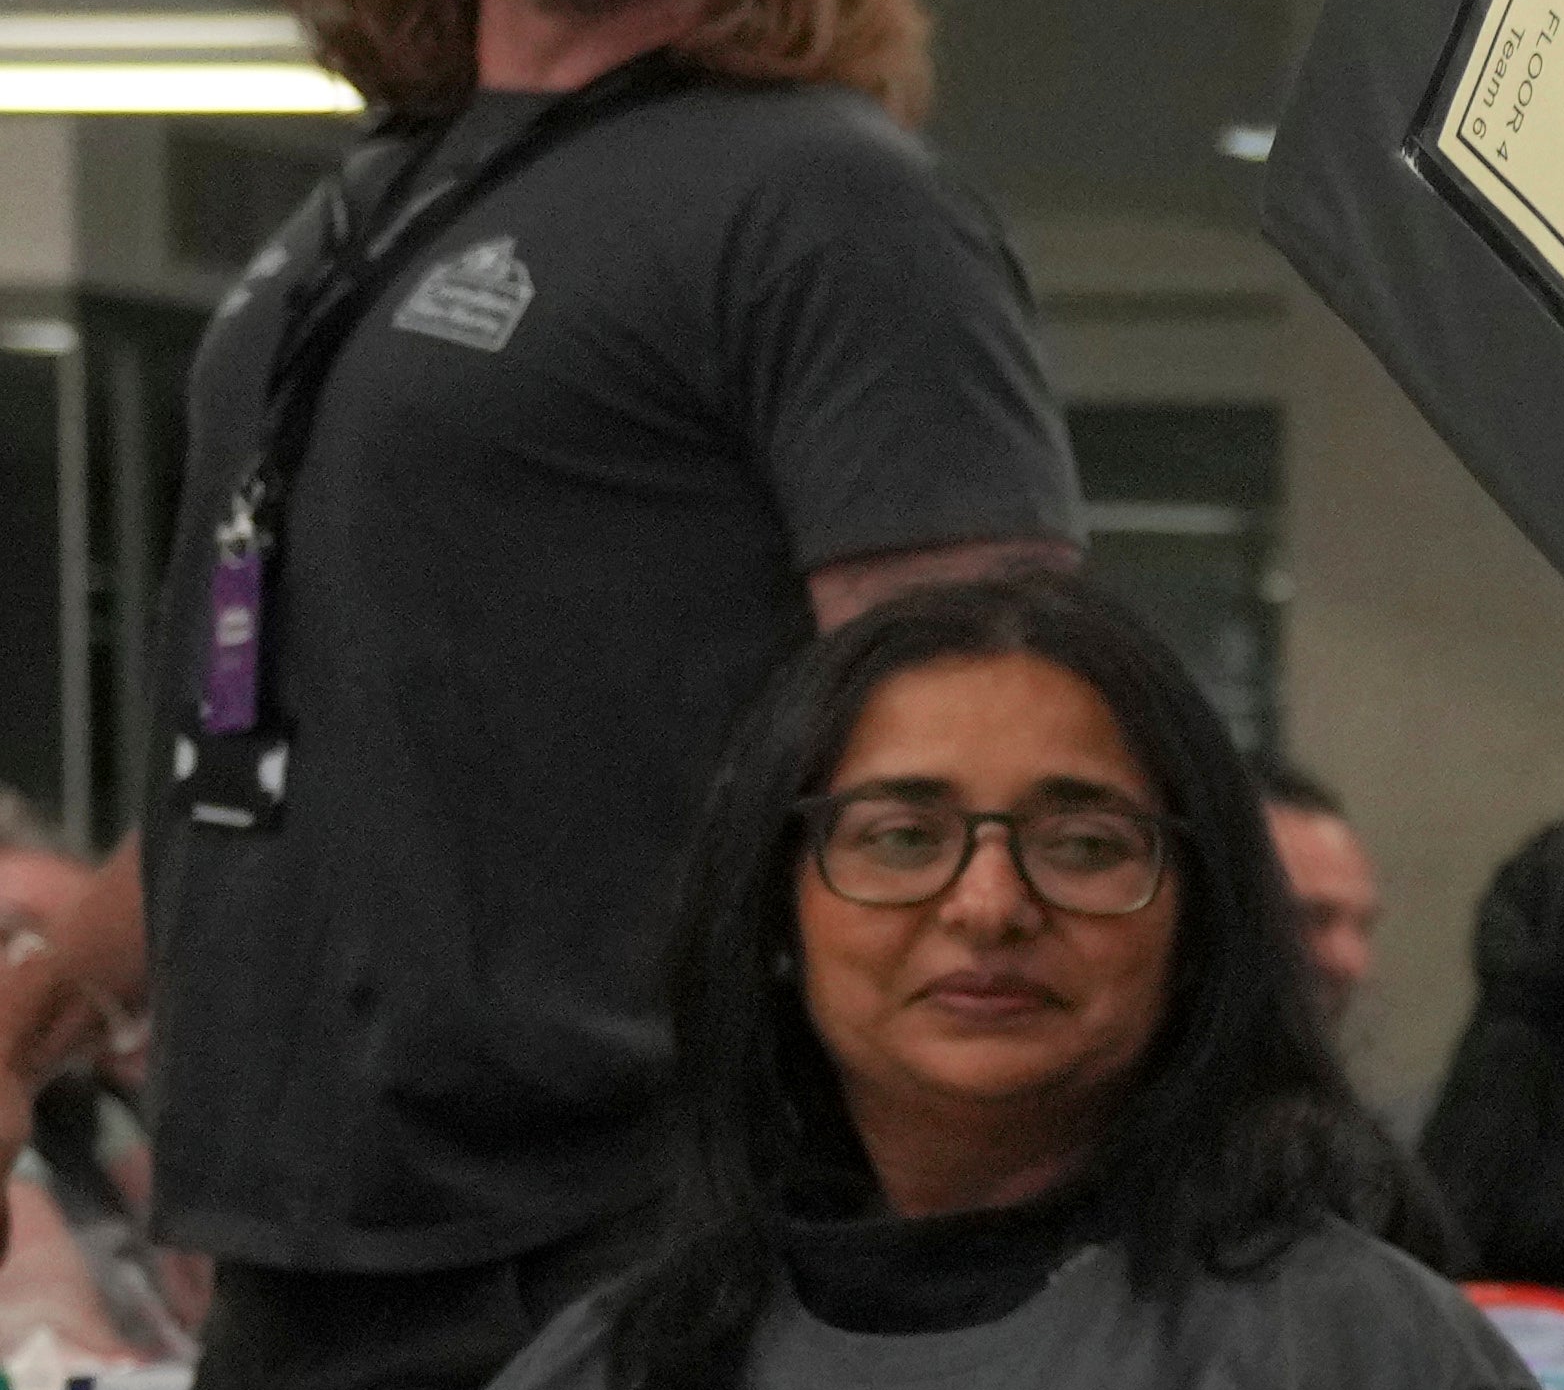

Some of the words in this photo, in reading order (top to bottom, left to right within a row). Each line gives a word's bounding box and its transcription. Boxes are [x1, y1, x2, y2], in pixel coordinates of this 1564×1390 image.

[1483, 27, 1525, 108] Team
[1506, 10, 1560, 134] FLOOR
[1471, 115, 1487, 140] 6
[1495, 140, 1510, 162] 4
